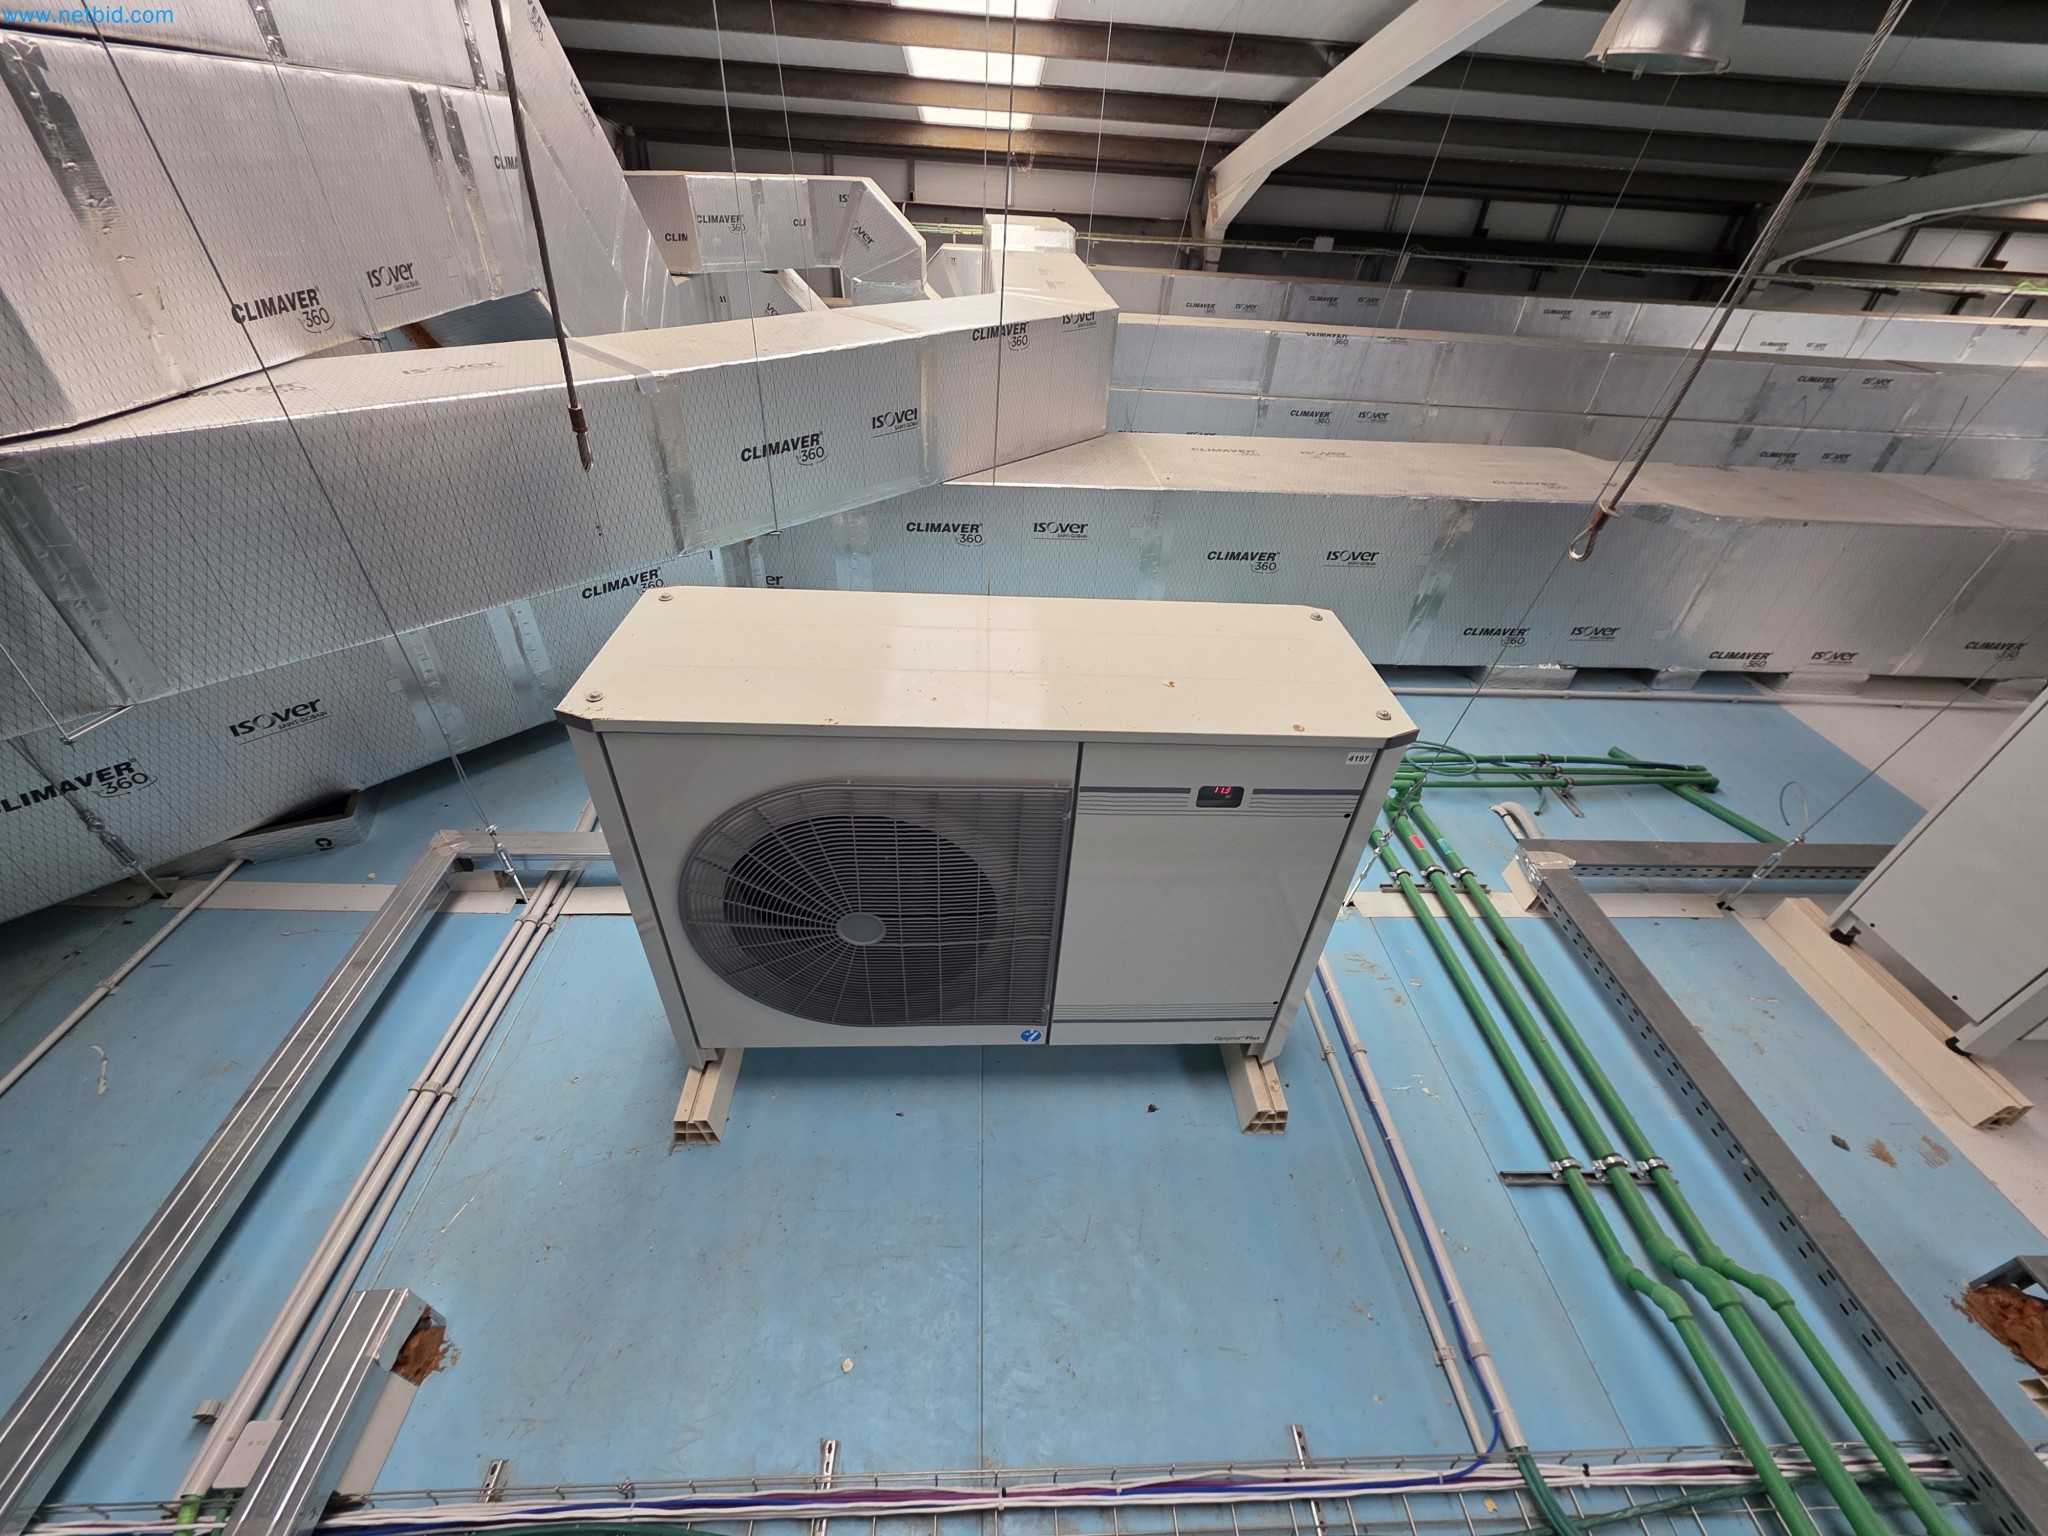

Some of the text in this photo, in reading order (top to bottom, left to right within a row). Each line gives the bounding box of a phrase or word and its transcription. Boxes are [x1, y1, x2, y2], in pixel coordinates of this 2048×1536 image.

[231, 288, 320, 324] CLIMAVER
[302, 307, 330, 328] 360
[972, 322, 1027, 342] CLIMAVER
[1010, 334, 1029, 348] 360
[1290, 409, 1331, 417] CLIMAVER
[740, 433, 820, 462] CLIMAVER
[800, 446, 825, 463] 360
[906, 522, 981, 534] CLIMAVER
[959, 534, 983, 543] 360
[1207, 551, 1277, 562] CLIMAVER
[1254, 561, 1277, 571] 360
[582, 567, 660, 599] CLIMAVER
[1463, 628, 1528, 636] CLIMAVER
[1504, 636, 1525, 645] 360
[1709, 651, 1771, 660] CLIMAVER
[0, 761, 137, 813] LIMAVER
[100, 772, 149, 795] 360
